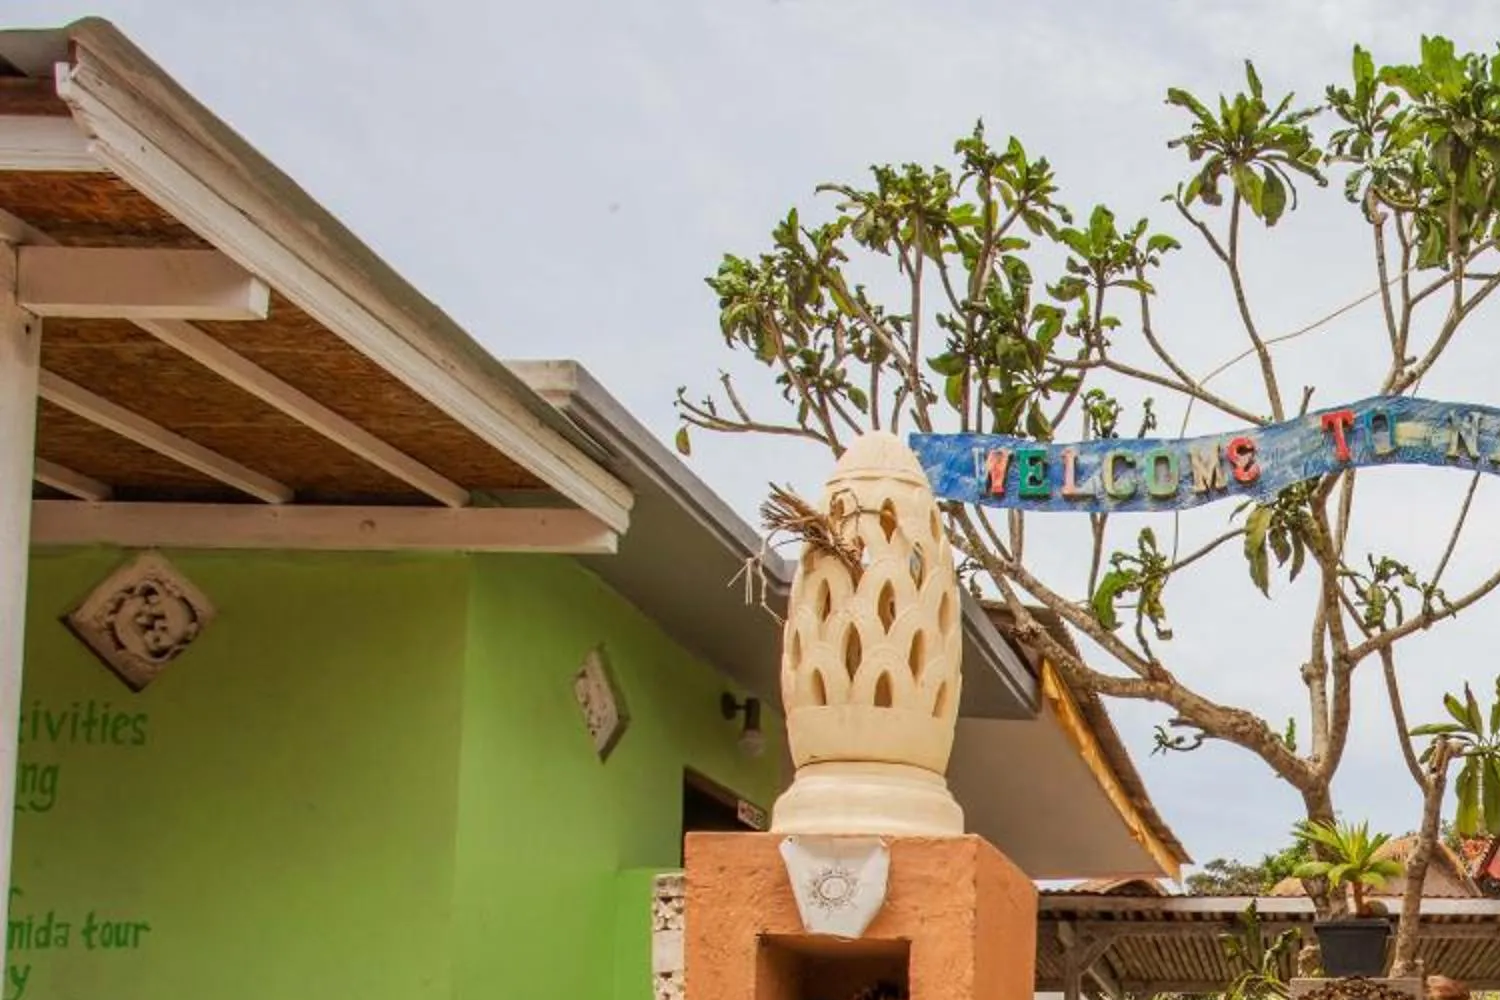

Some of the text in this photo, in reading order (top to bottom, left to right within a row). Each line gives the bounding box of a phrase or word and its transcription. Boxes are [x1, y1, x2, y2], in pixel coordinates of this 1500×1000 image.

[972, 436, 1262, 500] WELCOME
[1319, 407, 1398, 461] TO
[7, 910, 152, 951] nida tour
